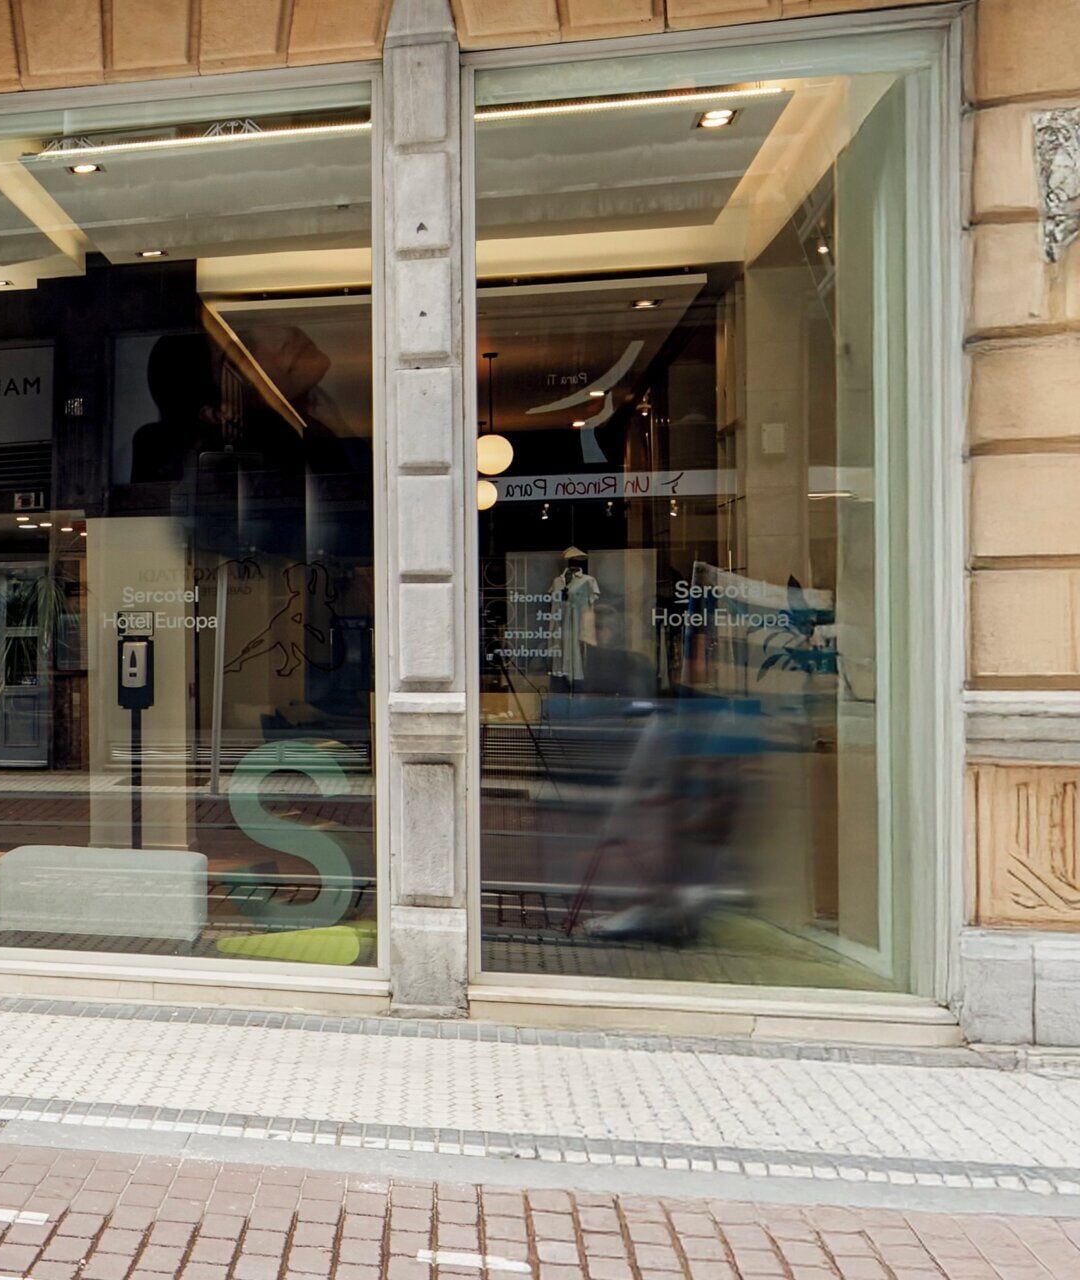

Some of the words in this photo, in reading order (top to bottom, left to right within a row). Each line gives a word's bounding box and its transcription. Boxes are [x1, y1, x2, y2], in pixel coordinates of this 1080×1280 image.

[122, 586, 199, 603] Sercotel
[674, 579, 767, 600] Sercotel
[103, 612, 151, 629] Hotel
[155, 612, 219, 633] Europa
[651, 608, 708, 627] Hotel
[714, 608, 790, 630] Europa
